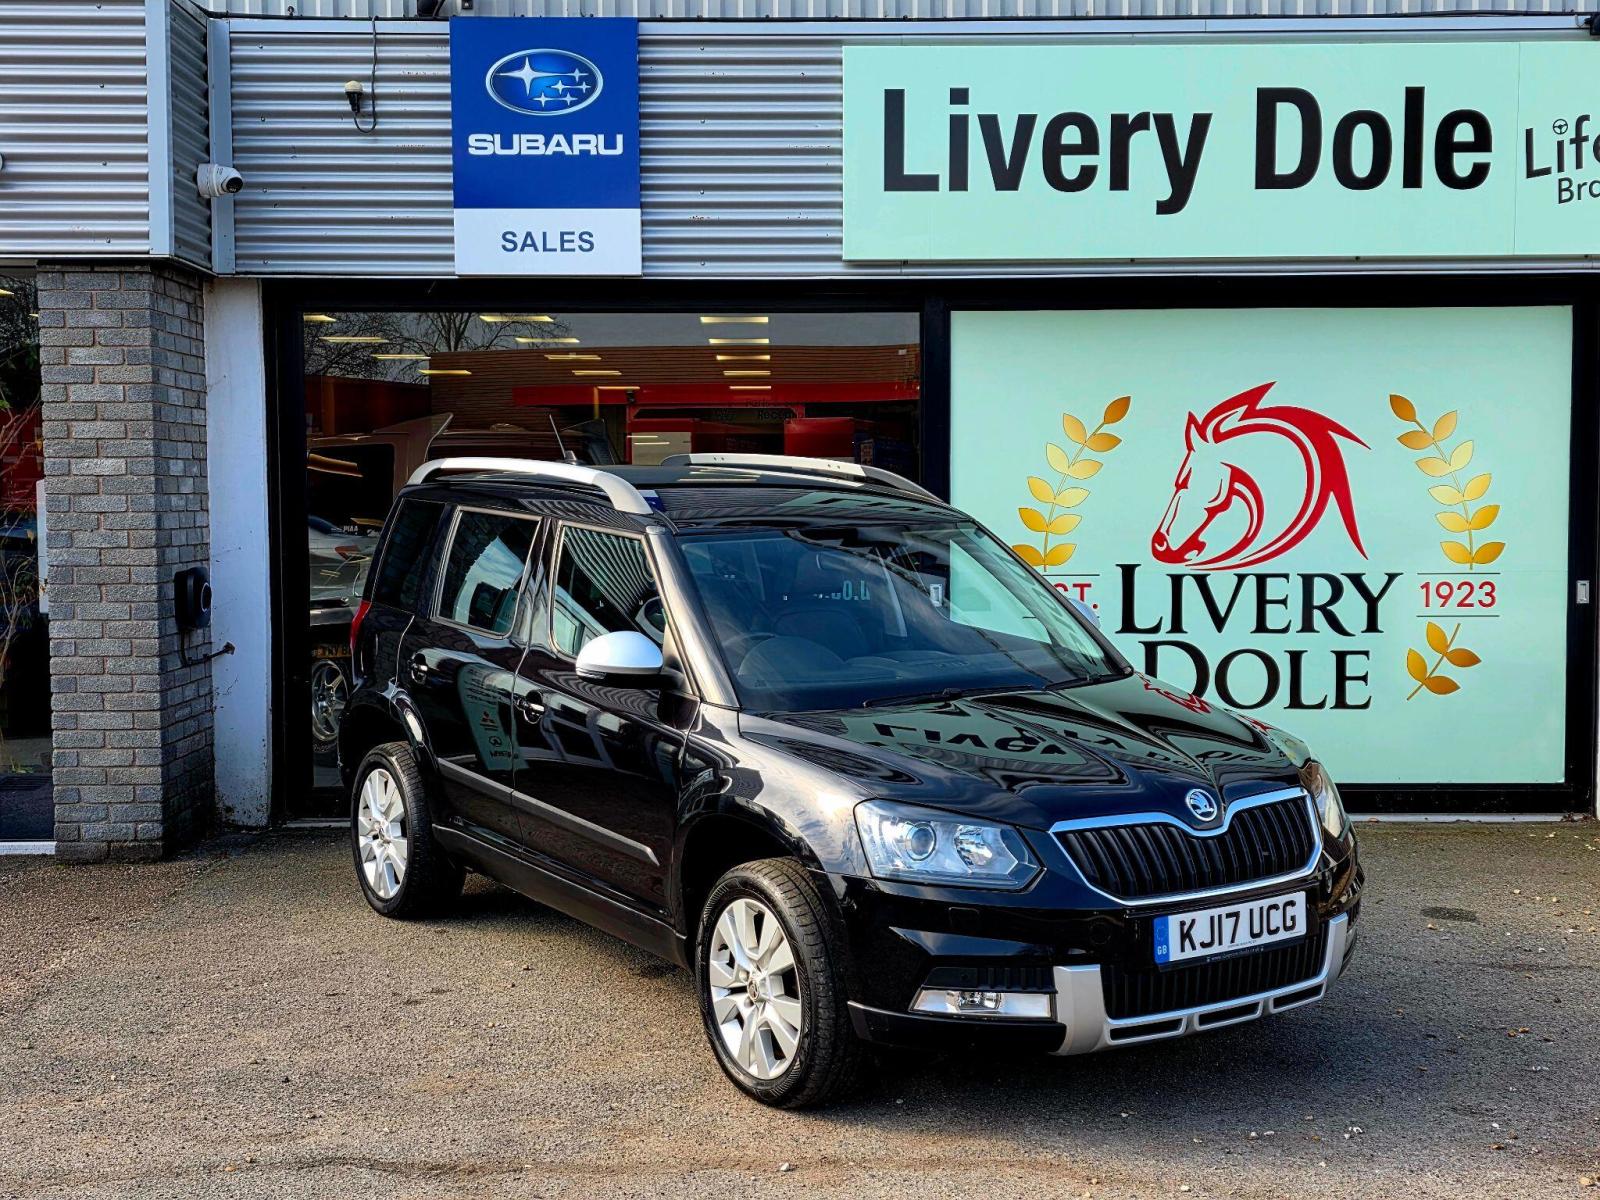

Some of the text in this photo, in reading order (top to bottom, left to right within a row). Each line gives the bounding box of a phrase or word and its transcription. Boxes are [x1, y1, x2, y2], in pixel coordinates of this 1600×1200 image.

[468, 133, 624, 156] SUBARU
[884, 86, 1493, 216] Livery Dole
[501, 231, 595, 253] SALES
[1114, 563, 1404, 637] LIVERY
[1419, 581, 1497, 608] 1923
[1138, 640, 1372, 710] DOLE
[1179, 899, 1297, 953] KJ17 UCG
[1157, 944, 1168, 955] GB
